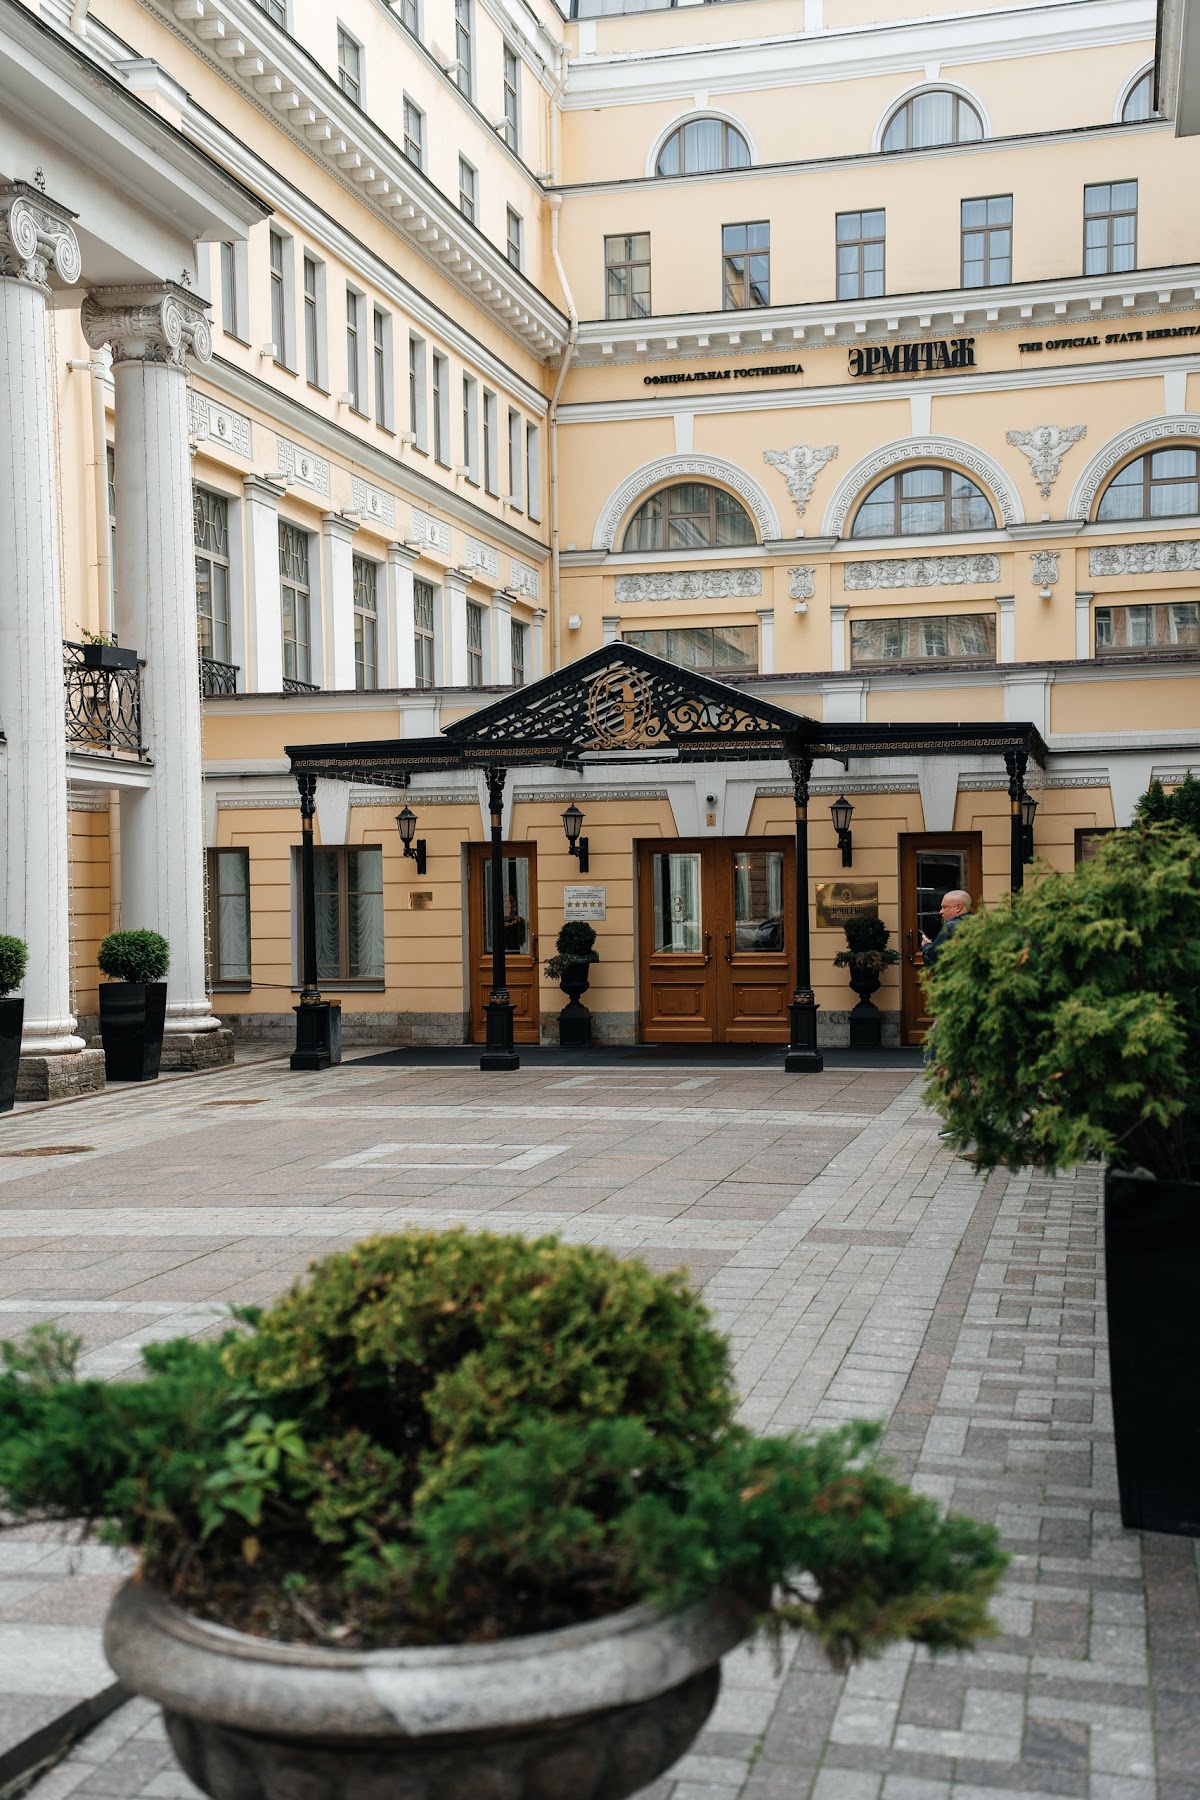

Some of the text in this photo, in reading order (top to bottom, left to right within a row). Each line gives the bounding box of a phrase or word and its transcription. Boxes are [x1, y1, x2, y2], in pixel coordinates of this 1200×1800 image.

[1018, 341, 1043, 353] THE
[1045, 336, 1101, 350] OFFICIAL
[1105, 331, 1143, 344] STATE
[848, 337, 977, 377] ЭРМИТАЖ
[643, 364, 804, 385] ОФИЦИАЛЬНАЯ ГОСТИНИЦА
